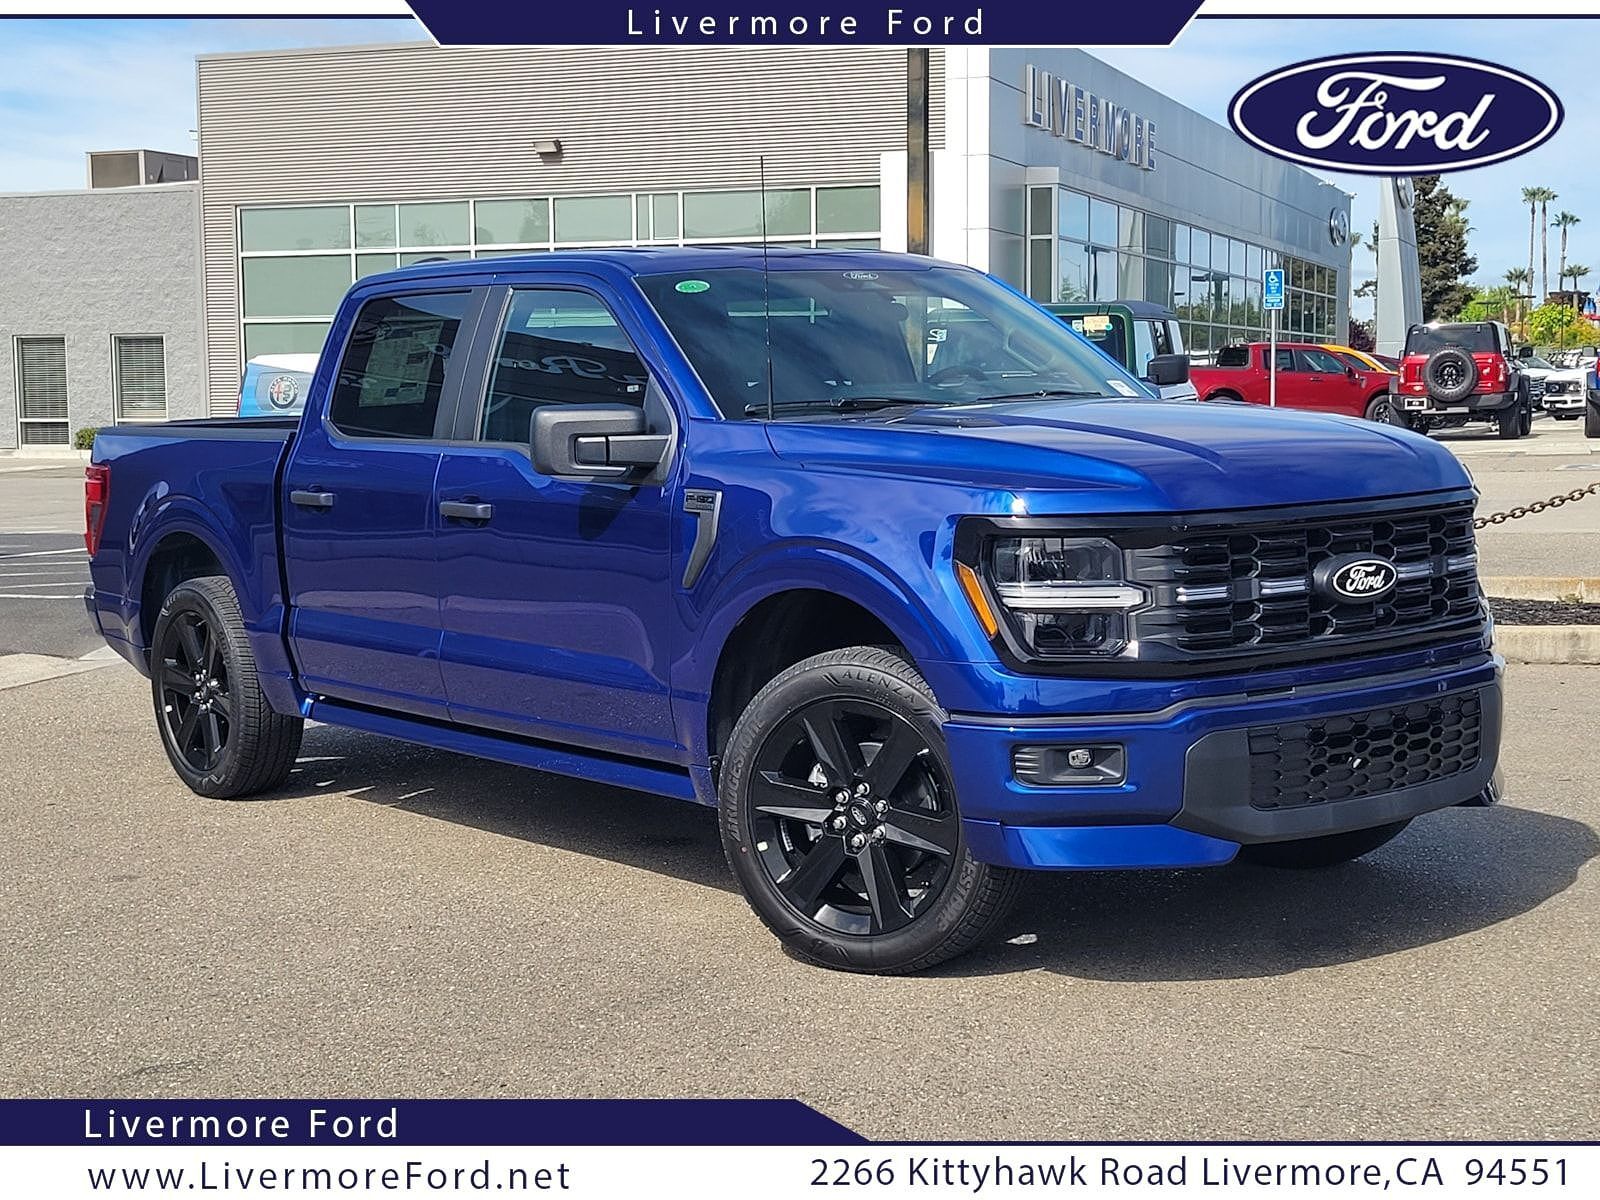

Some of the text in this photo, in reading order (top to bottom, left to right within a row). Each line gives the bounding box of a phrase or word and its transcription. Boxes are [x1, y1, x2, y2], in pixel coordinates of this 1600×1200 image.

[1024, 63, 1157, 171] LIVERMORE
[1345, 565, 1386, 592] Ford
[842, 669, 915, 703] ALENZA
